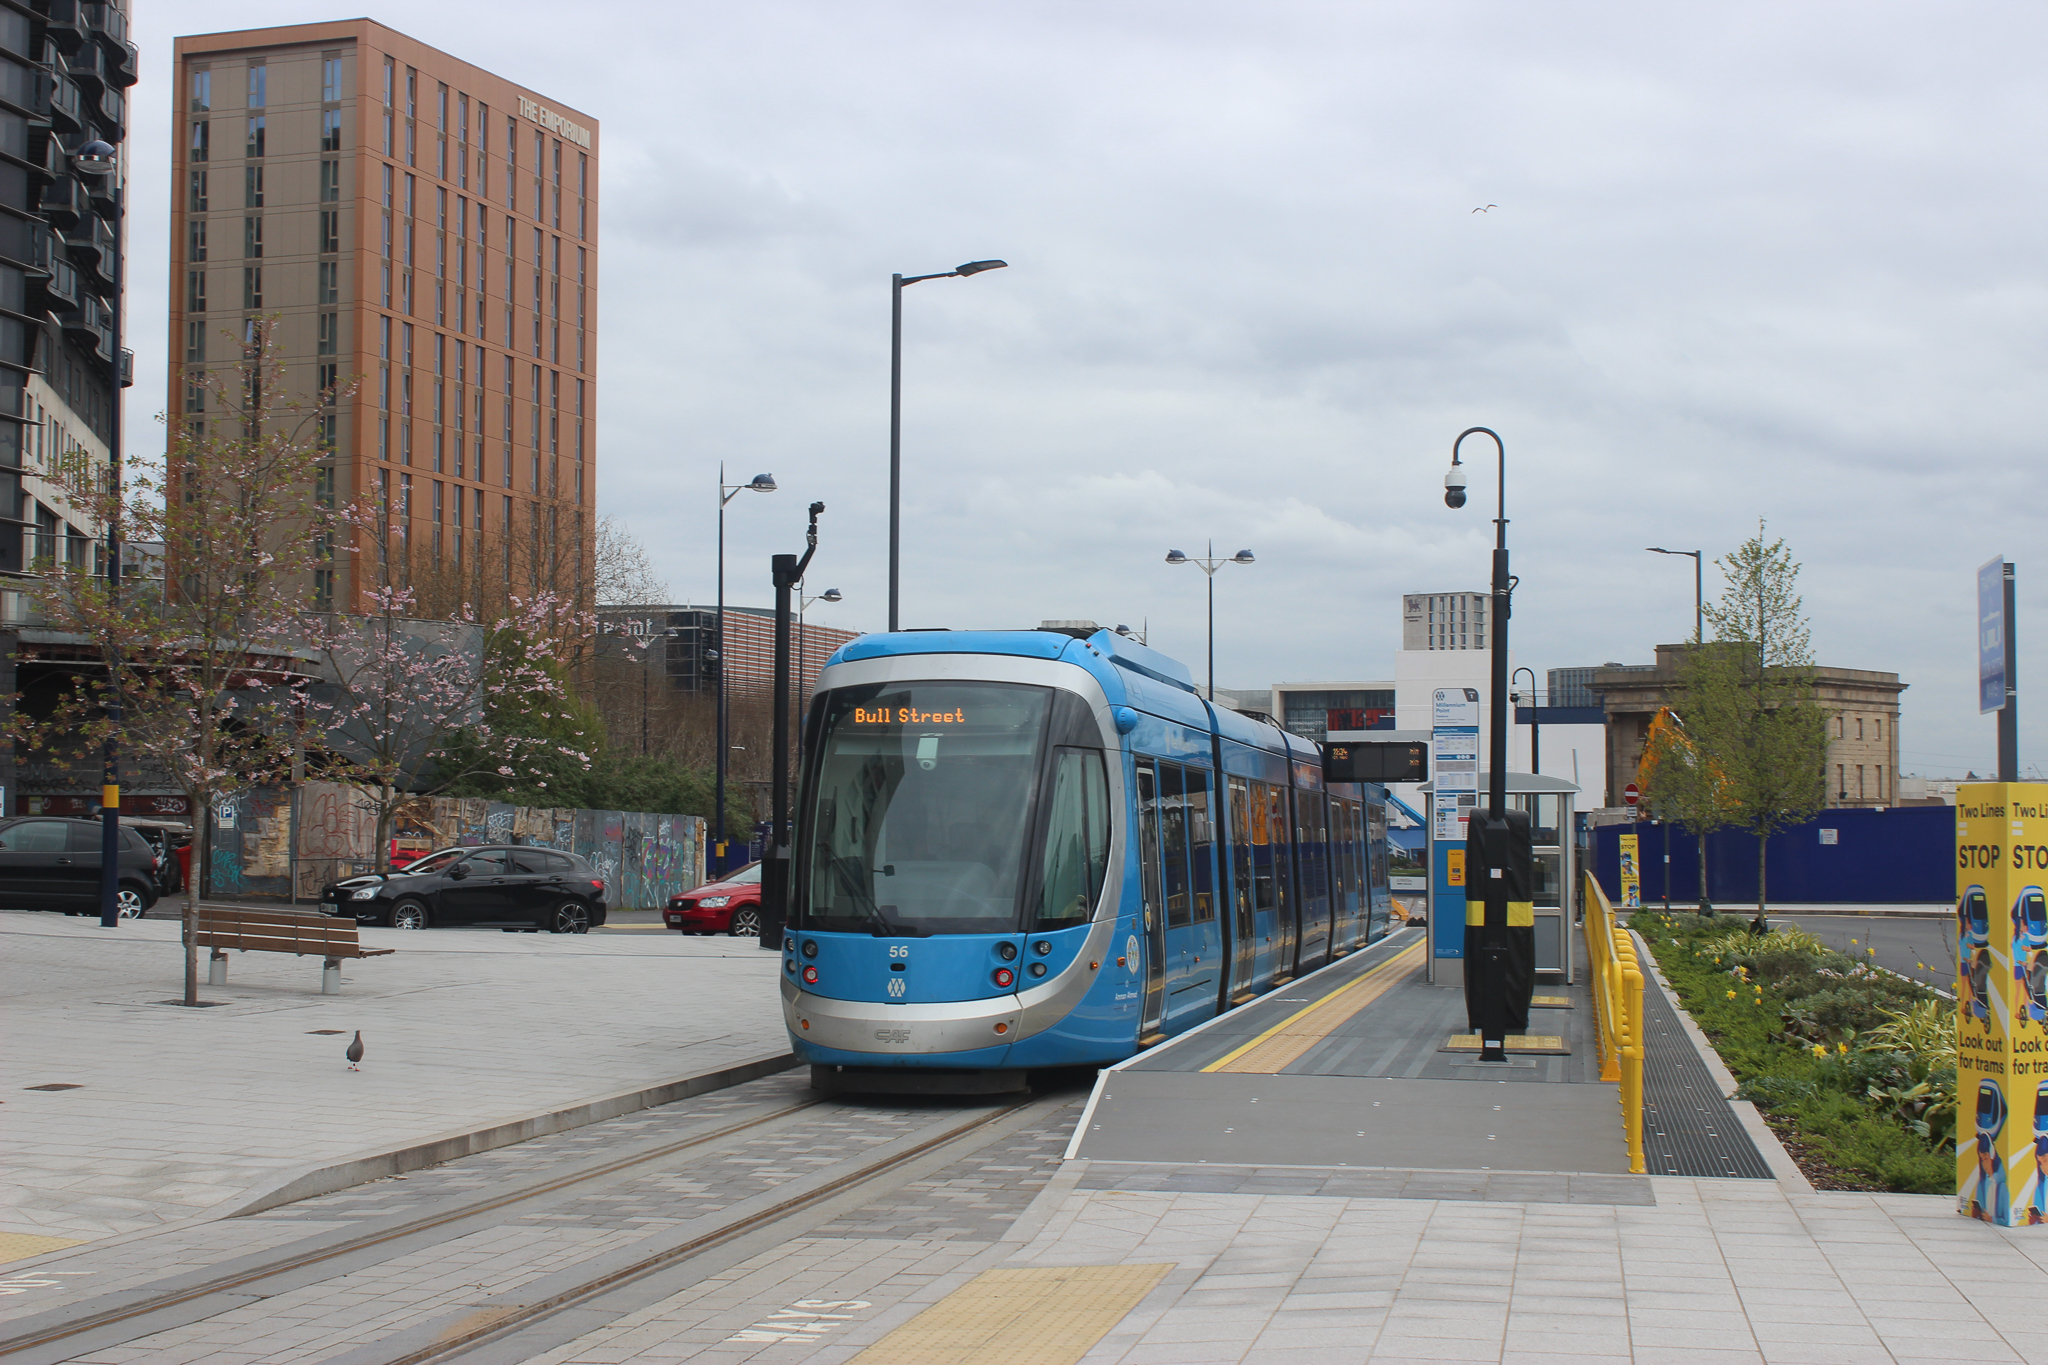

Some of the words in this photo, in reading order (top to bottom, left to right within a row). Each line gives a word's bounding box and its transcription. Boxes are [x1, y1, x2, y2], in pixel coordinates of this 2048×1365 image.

[517, 95, 538, 123] THE
[539, 105, 590, 150] EMPORIUM
[855, 707, 891, 723] Bull
[898, 707, 965, 723] Street
[222, 806, 231, 817] P
[1958, 803, 1979, 818] Two
[1980, 802, 2005, 818] Lines
[2012, 802, 2037, 818] Two
[1959, 844, 2001, 869] STOP
[888, 945, 909, 958] 56
[874, 1028, 911, 1043] CAF
[1959, 1031, 1983, 1050] Look
[1985, 1037, 2003, 1053] out
[2013, 1036, 2042, 1053] Look
[1959, 1051, 1974, 1069] for
[1975, 1056, 2005, 1074] trams
[2012, 1058, 2031, 1075] for
[723, 1299, 873, 1343] WAYS
